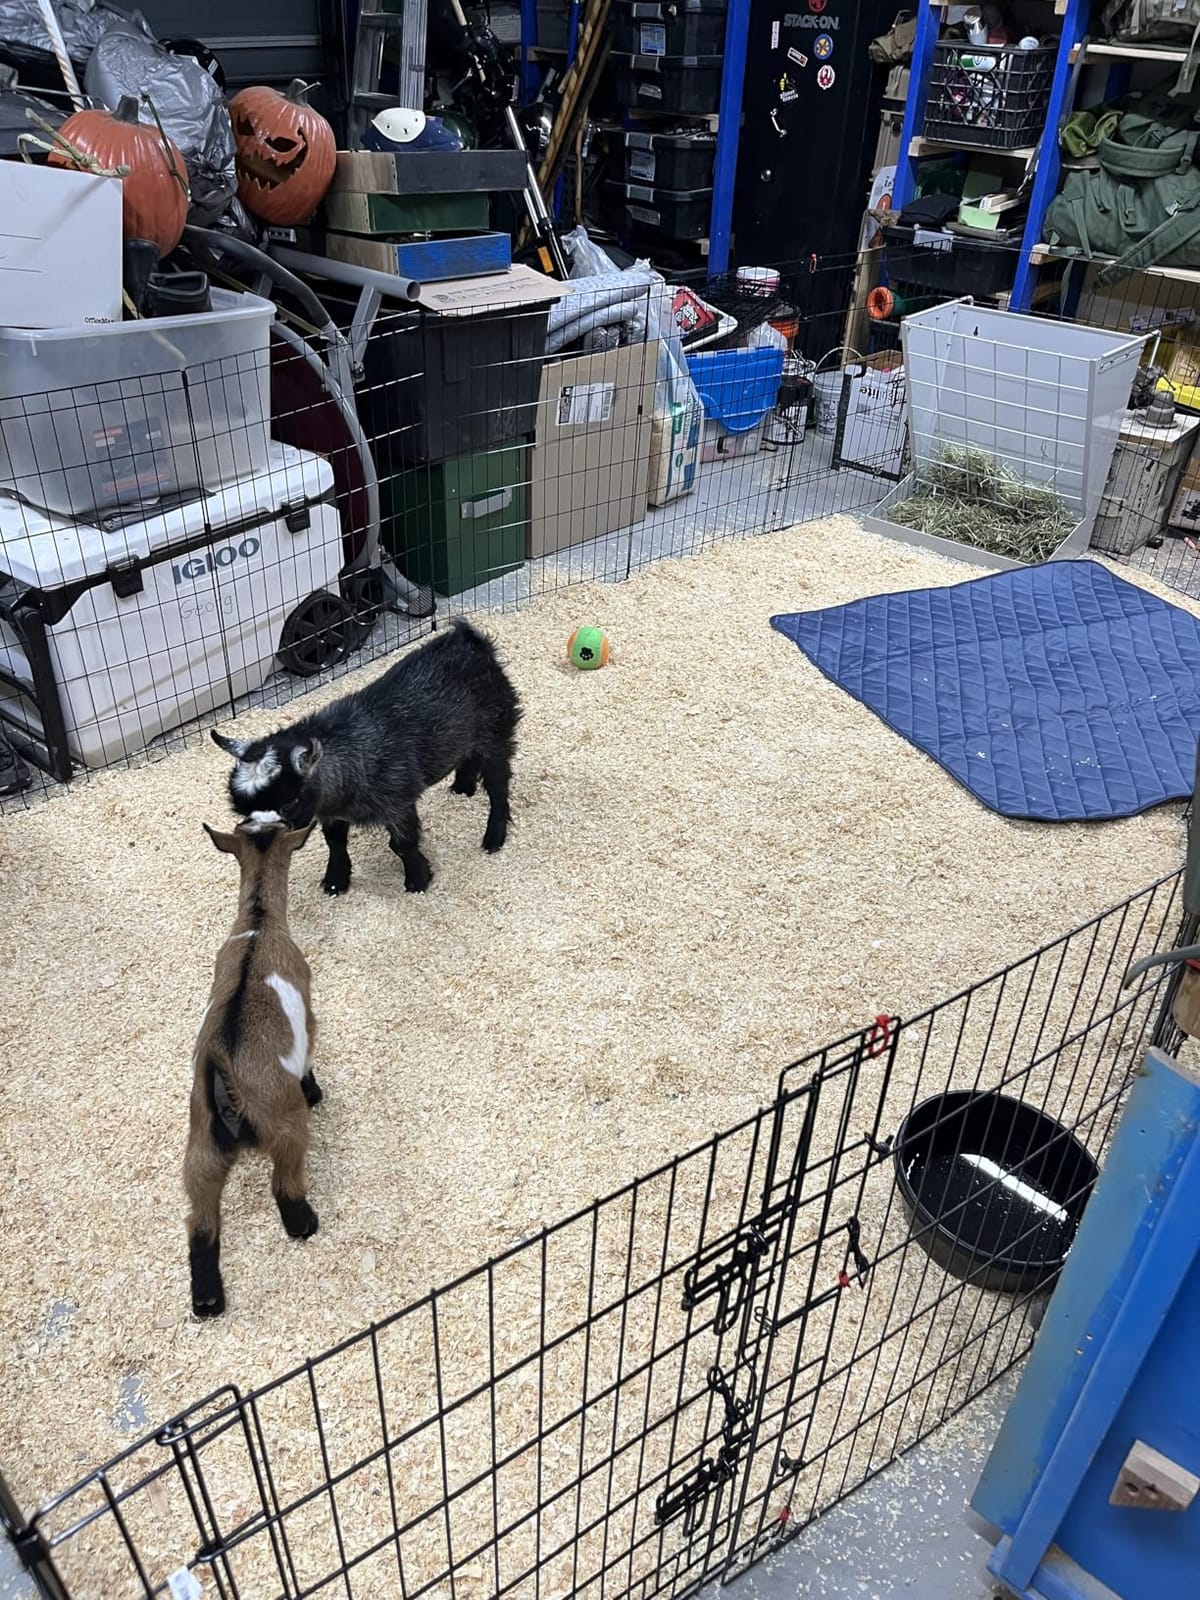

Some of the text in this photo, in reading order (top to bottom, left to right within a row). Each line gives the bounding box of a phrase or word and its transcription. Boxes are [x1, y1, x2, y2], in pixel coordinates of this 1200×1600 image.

[783, 14, 840, 30] STACK-ON
[173, 537, 260, 585] IGLOO
[181, 595, 233, 619] Geog
